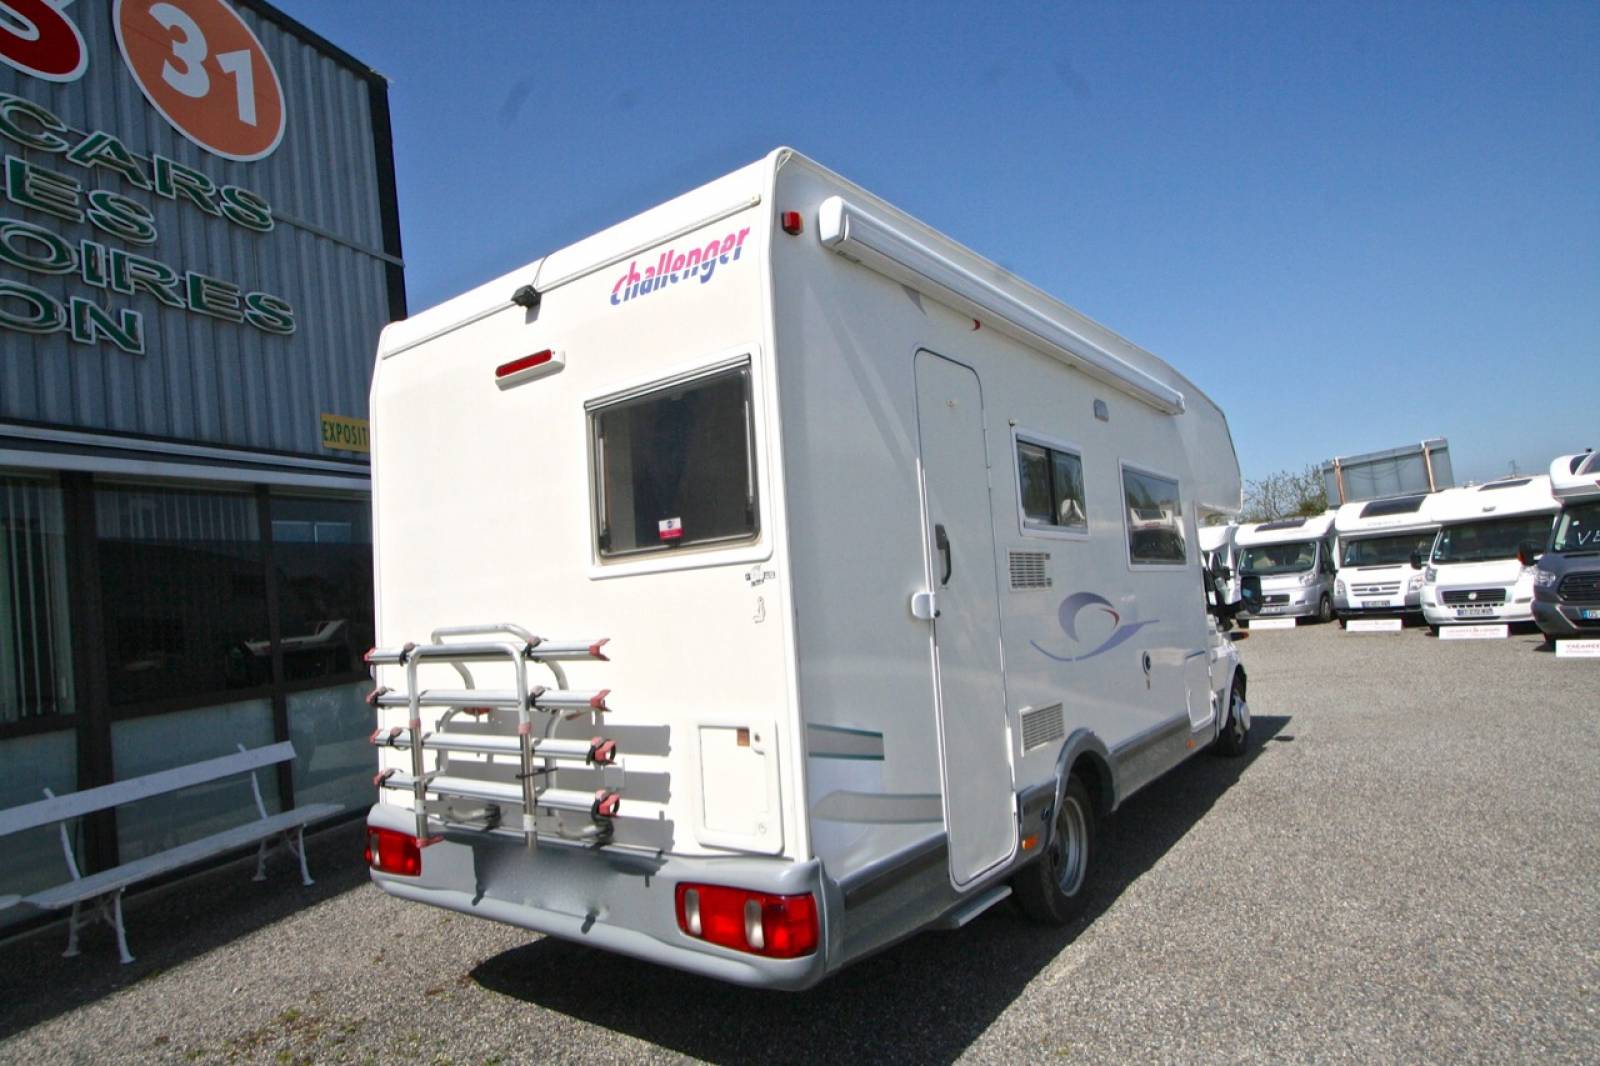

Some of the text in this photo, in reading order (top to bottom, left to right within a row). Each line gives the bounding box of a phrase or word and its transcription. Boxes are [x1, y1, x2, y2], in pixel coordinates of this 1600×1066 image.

[149, 2, 257, 127] 31
[0, 92, 275, 232] CARS
[610, 226, 750, 306] Challenger
